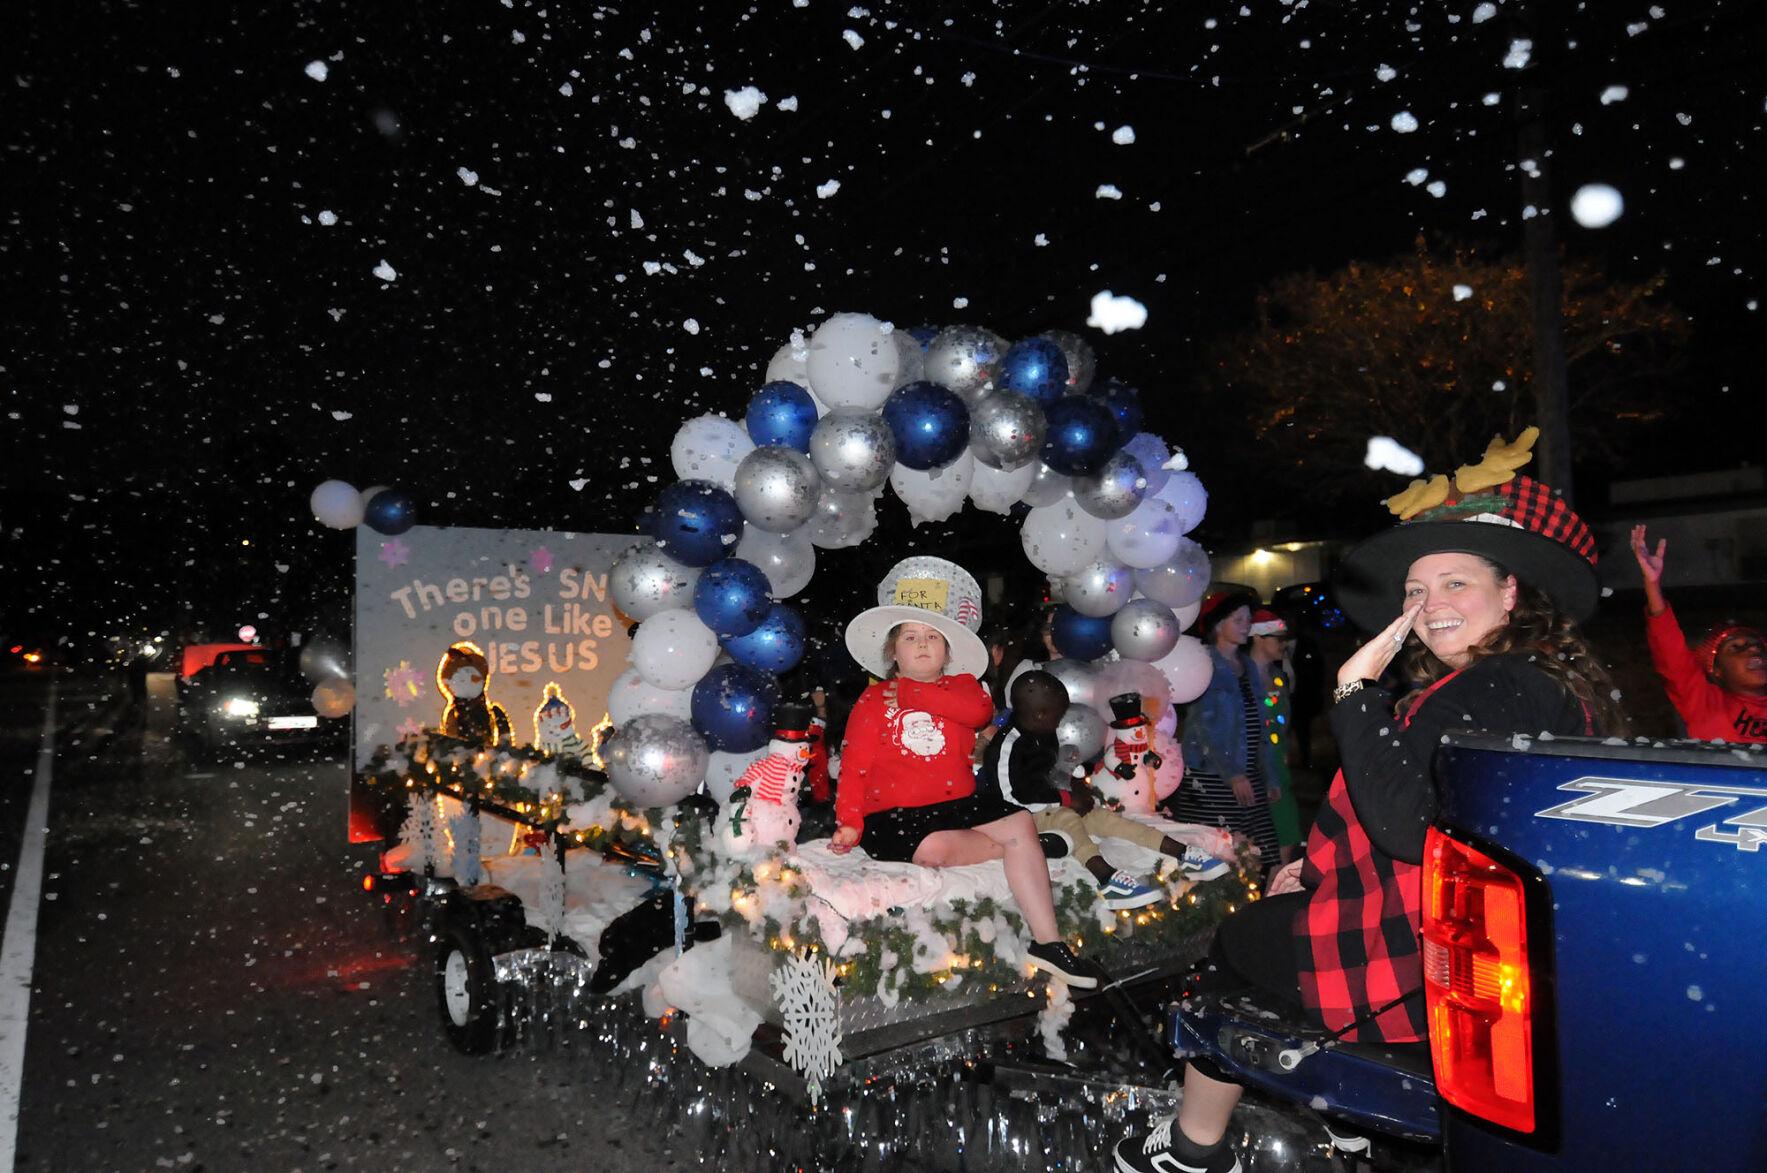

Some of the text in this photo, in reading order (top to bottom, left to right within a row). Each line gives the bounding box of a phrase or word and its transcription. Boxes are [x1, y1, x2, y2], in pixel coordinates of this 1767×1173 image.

[390, 564, 532, 619] There's
[896, 601, 942, 609] ANTA
[900, 590, 928, 600] FOR
[453, 603, 612, 638] one Like
[488, 639, 599, 674] JESUS
